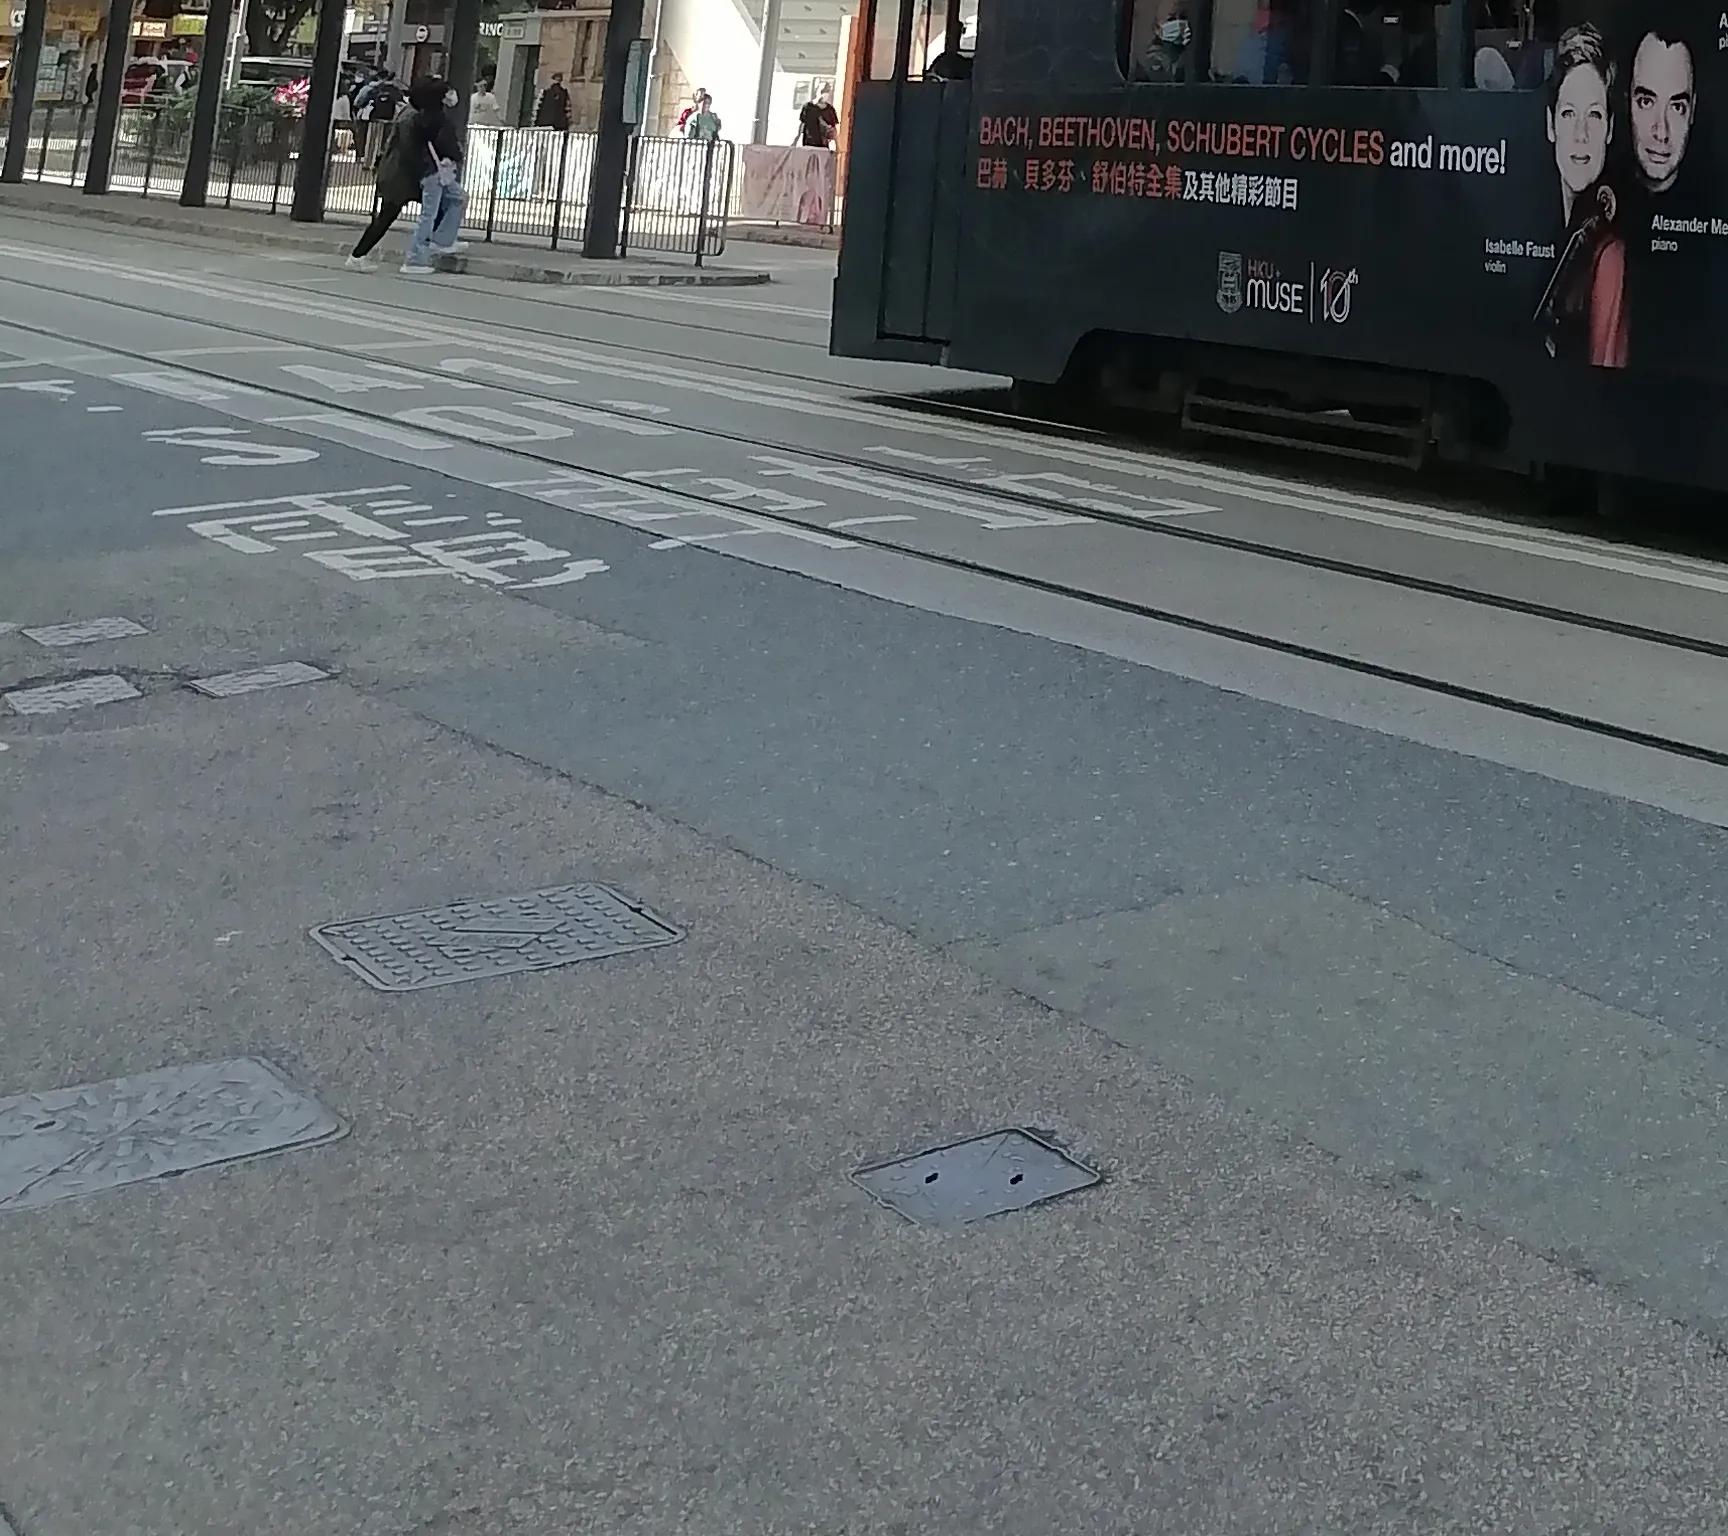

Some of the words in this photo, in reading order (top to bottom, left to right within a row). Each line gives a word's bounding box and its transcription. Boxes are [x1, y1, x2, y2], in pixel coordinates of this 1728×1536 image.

[979, 115, 1033, 149] BACH,
[1038, 117, 1160, 156] BEETHOVEN,
[1166, 121, 1285, 159] SCHUBERT
[1290, 130, 1385, 167] CYCLES
[1389, 134, 1433, 168] and
[1438, 139, 1507, 174] more!
[1651, 214, 1708, 234] Alexander
[1485, 238, 1524, 256] Isabelle
[1526, 241, 1556, 258] Faust
[1650, 236, 1678, 251] piano
[1247, 258, 1275, 280] HKU
